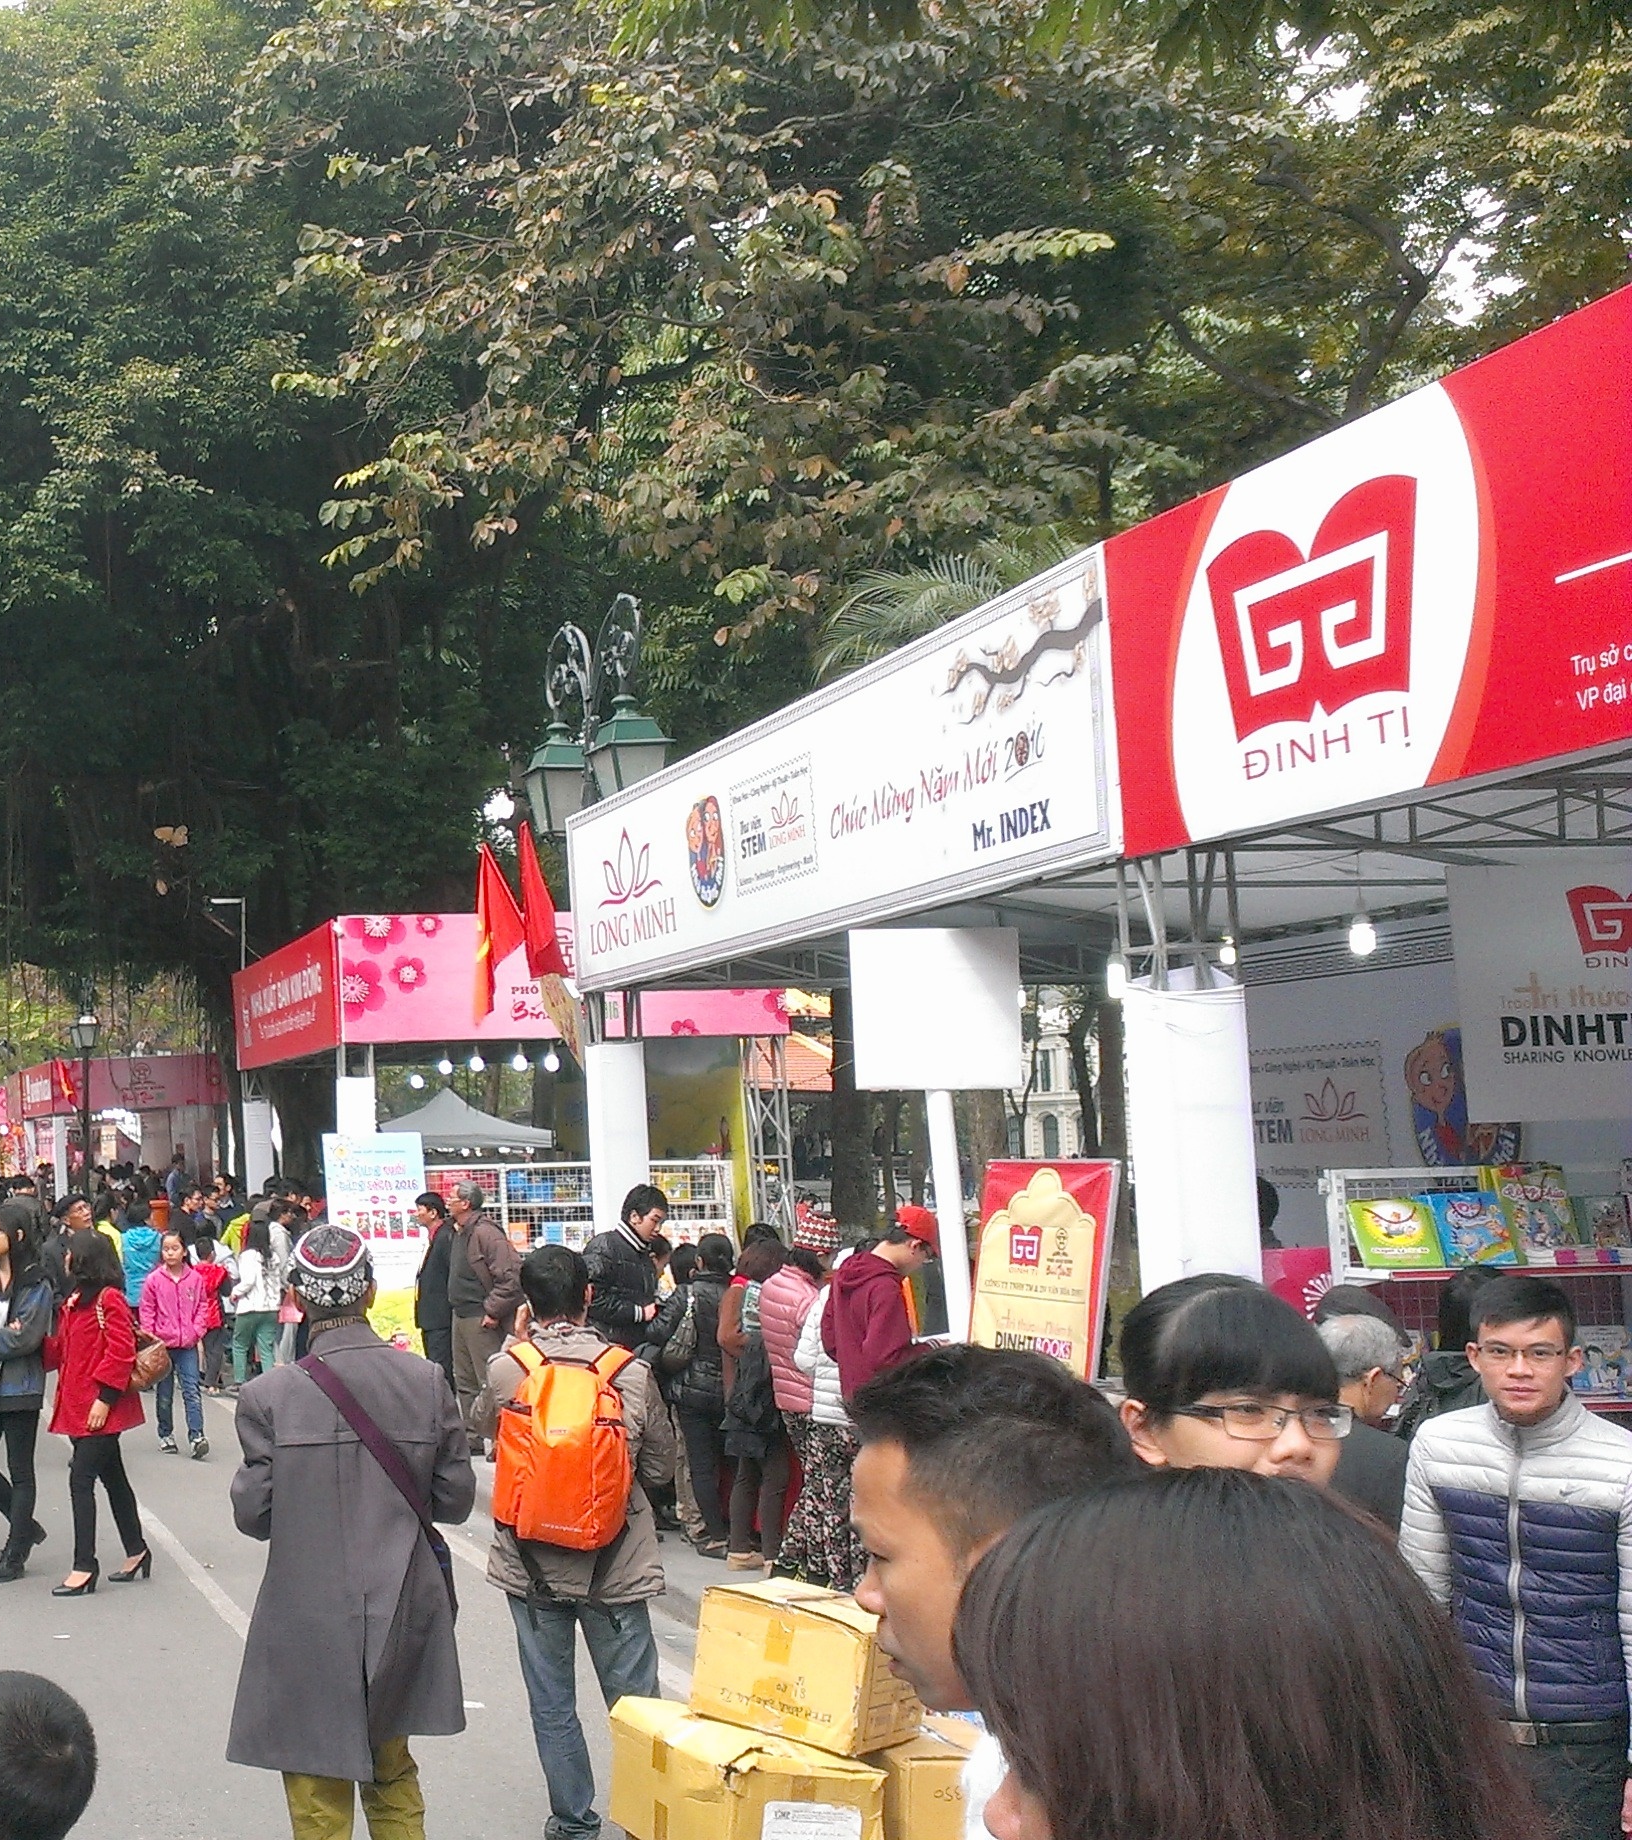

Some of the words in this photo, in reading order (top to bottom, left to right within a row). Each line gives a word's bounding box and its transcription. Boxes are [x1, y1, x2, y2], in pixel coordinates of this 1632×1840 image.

[1570, 654, 1597, 676] Trụ
[1599, 643, 1620, 668] sở
[1575, 686, 1600, 711] VP
[1603, 678, 1627, 705] đại
[1242, 723, 1351, 780] ĐINH
[1367, 706, 1411, 748] TỊ
[830, 795, 867, 840] Chúc
[920, 764, 959, 809] Năm
[963, 740, 999, 793] Mới
[740, 831, 767, 860] STEM
[768, 831, 787, 850] LONG
[788, 824, 806, 842] MINH
[971, 820, 996, 852] Mr.
[1000, 798, 1052, 844] INDEX
[590, 913, 630, 956] LONG
[633, 897, 677, 943] MINH
[511, 984, 539, 995] PHỐ
[1503, 1050, 1565, 1065] SHARING
[1255, 1119, 1294, 1144] TEM
